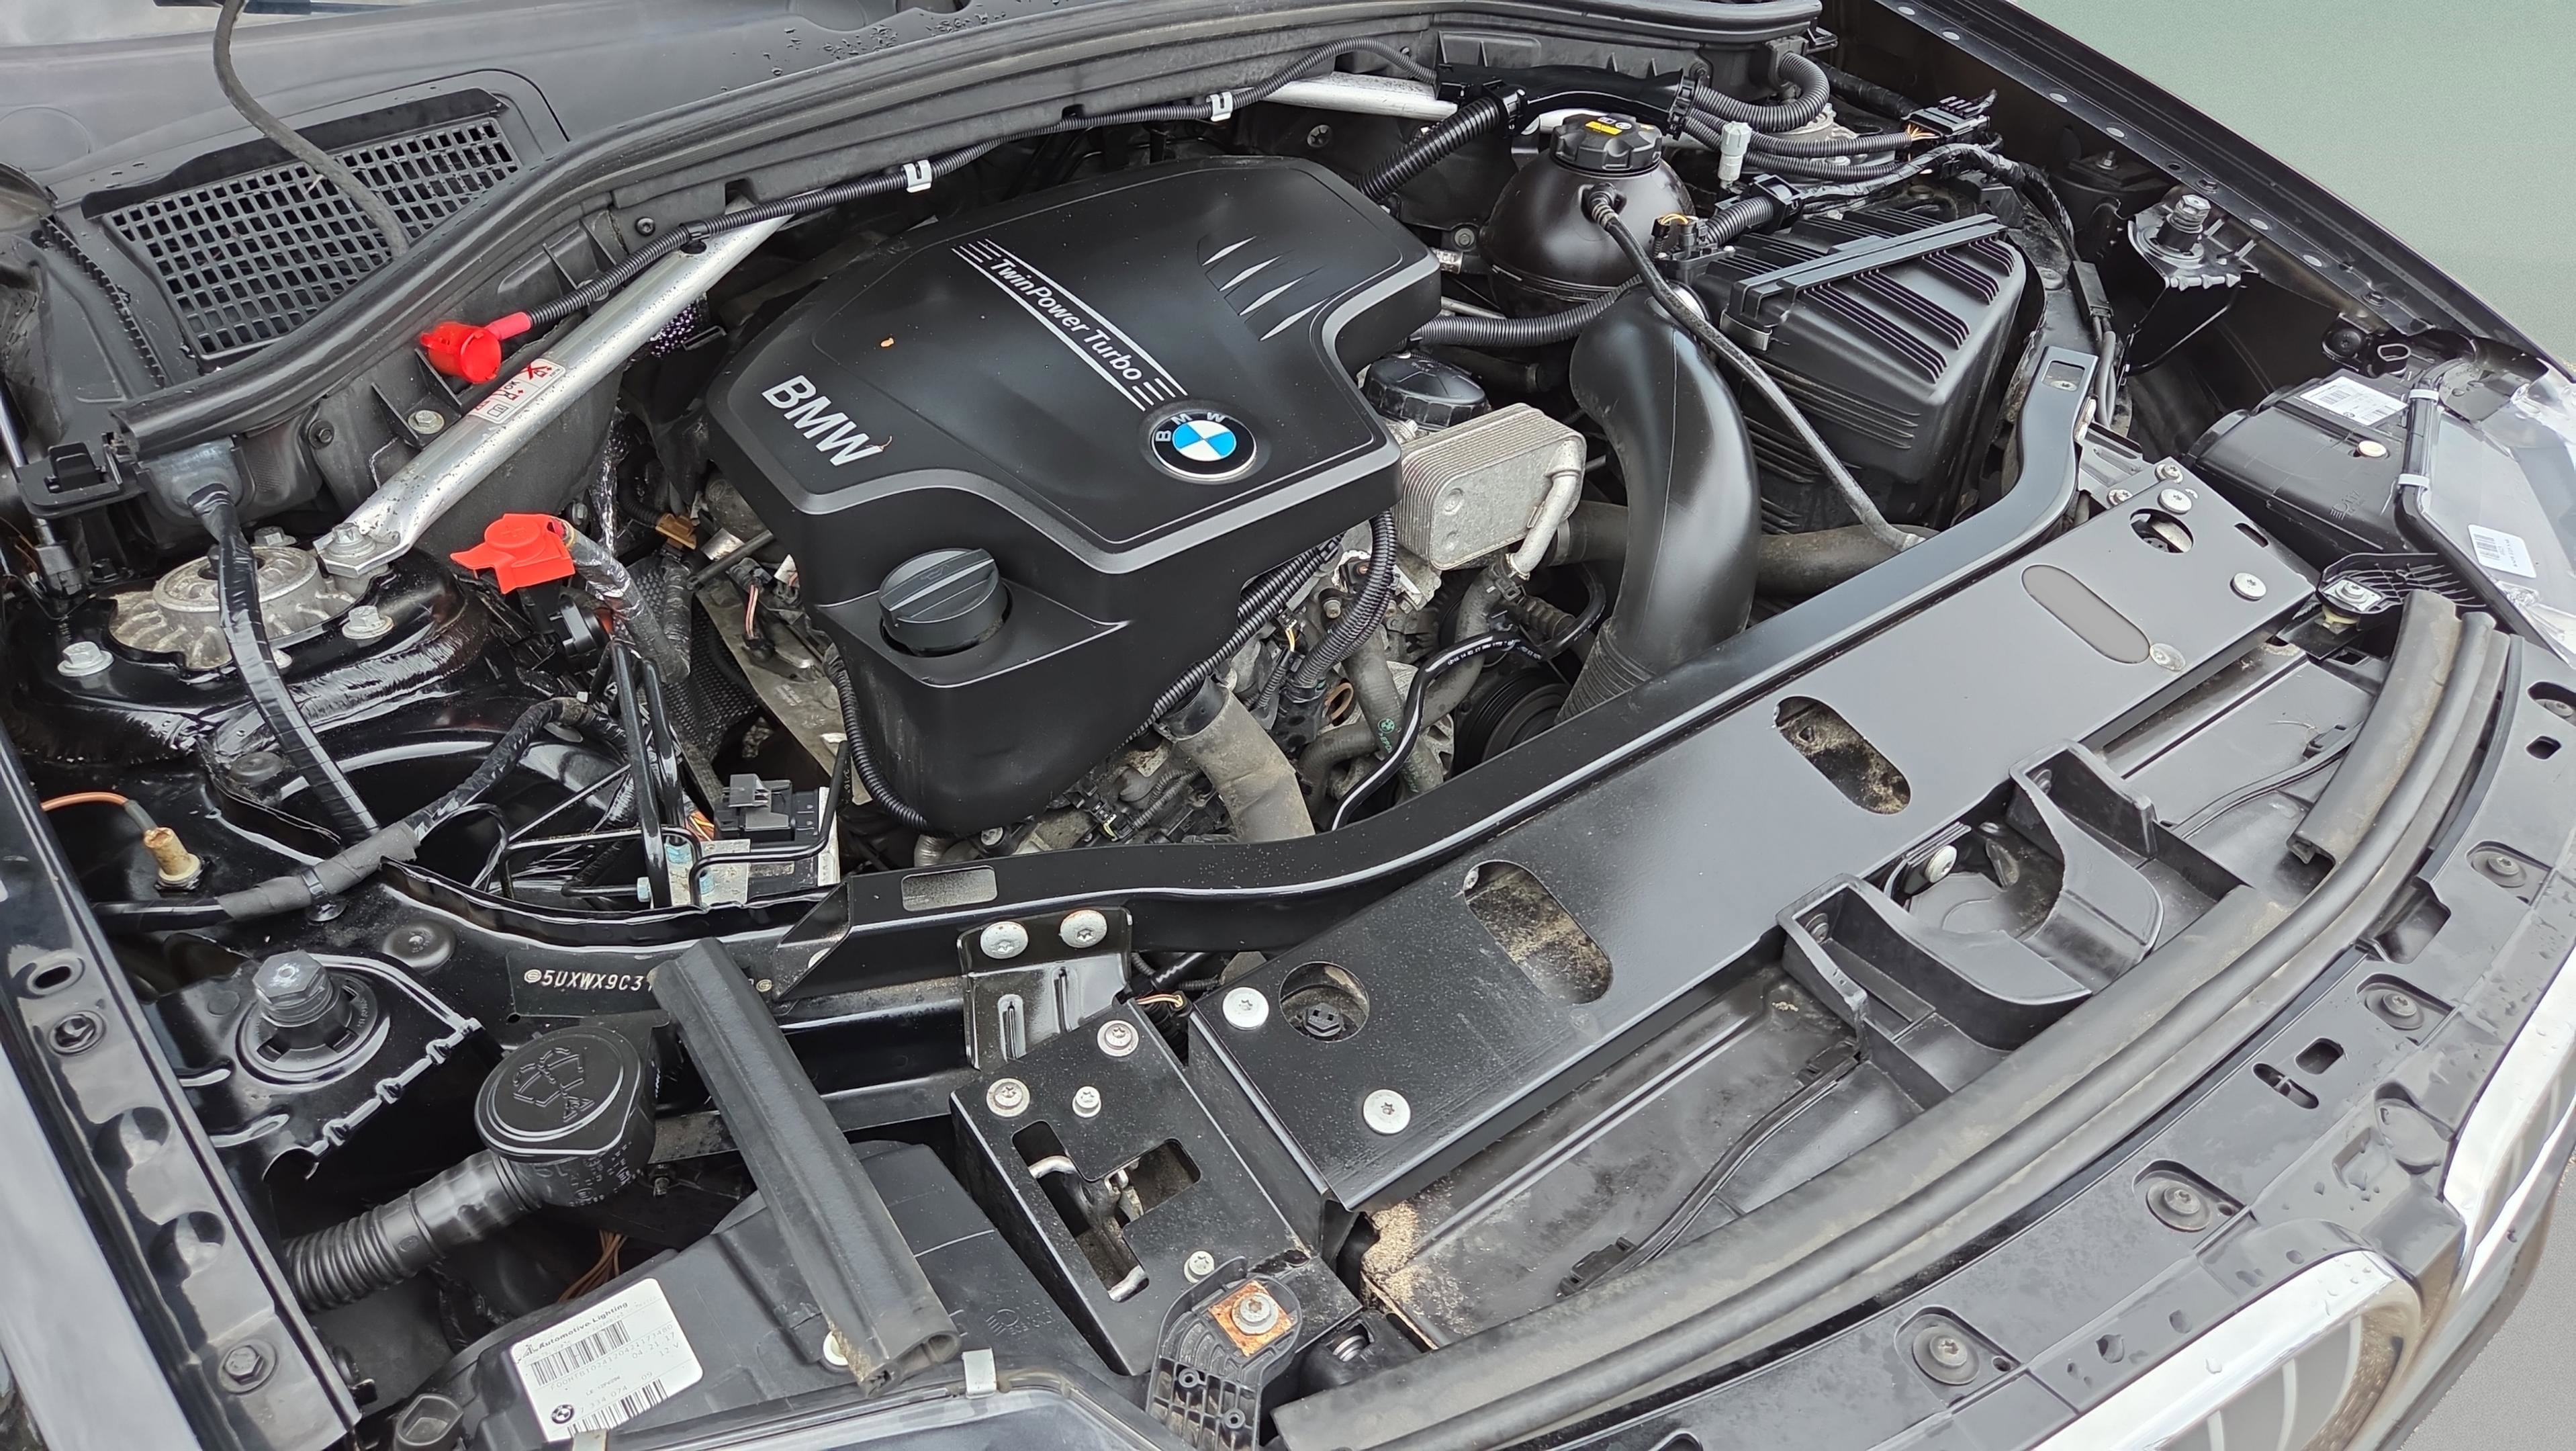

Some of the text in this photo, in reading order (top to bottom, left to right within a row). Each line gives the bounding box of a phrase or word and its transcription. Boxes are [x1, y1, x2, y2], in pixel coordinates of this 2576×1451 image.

[991, 259, 1142, 380] TwinPower Turbo
[762, 375, 884, 466] BMW
[1156, 412, 1227, 442] BMW
[541, 969, 653, 992] 5UXWX9C3
[539, 1321, 591, 1349] Automotive
[592, 1302, 629, 1325] Lighting
